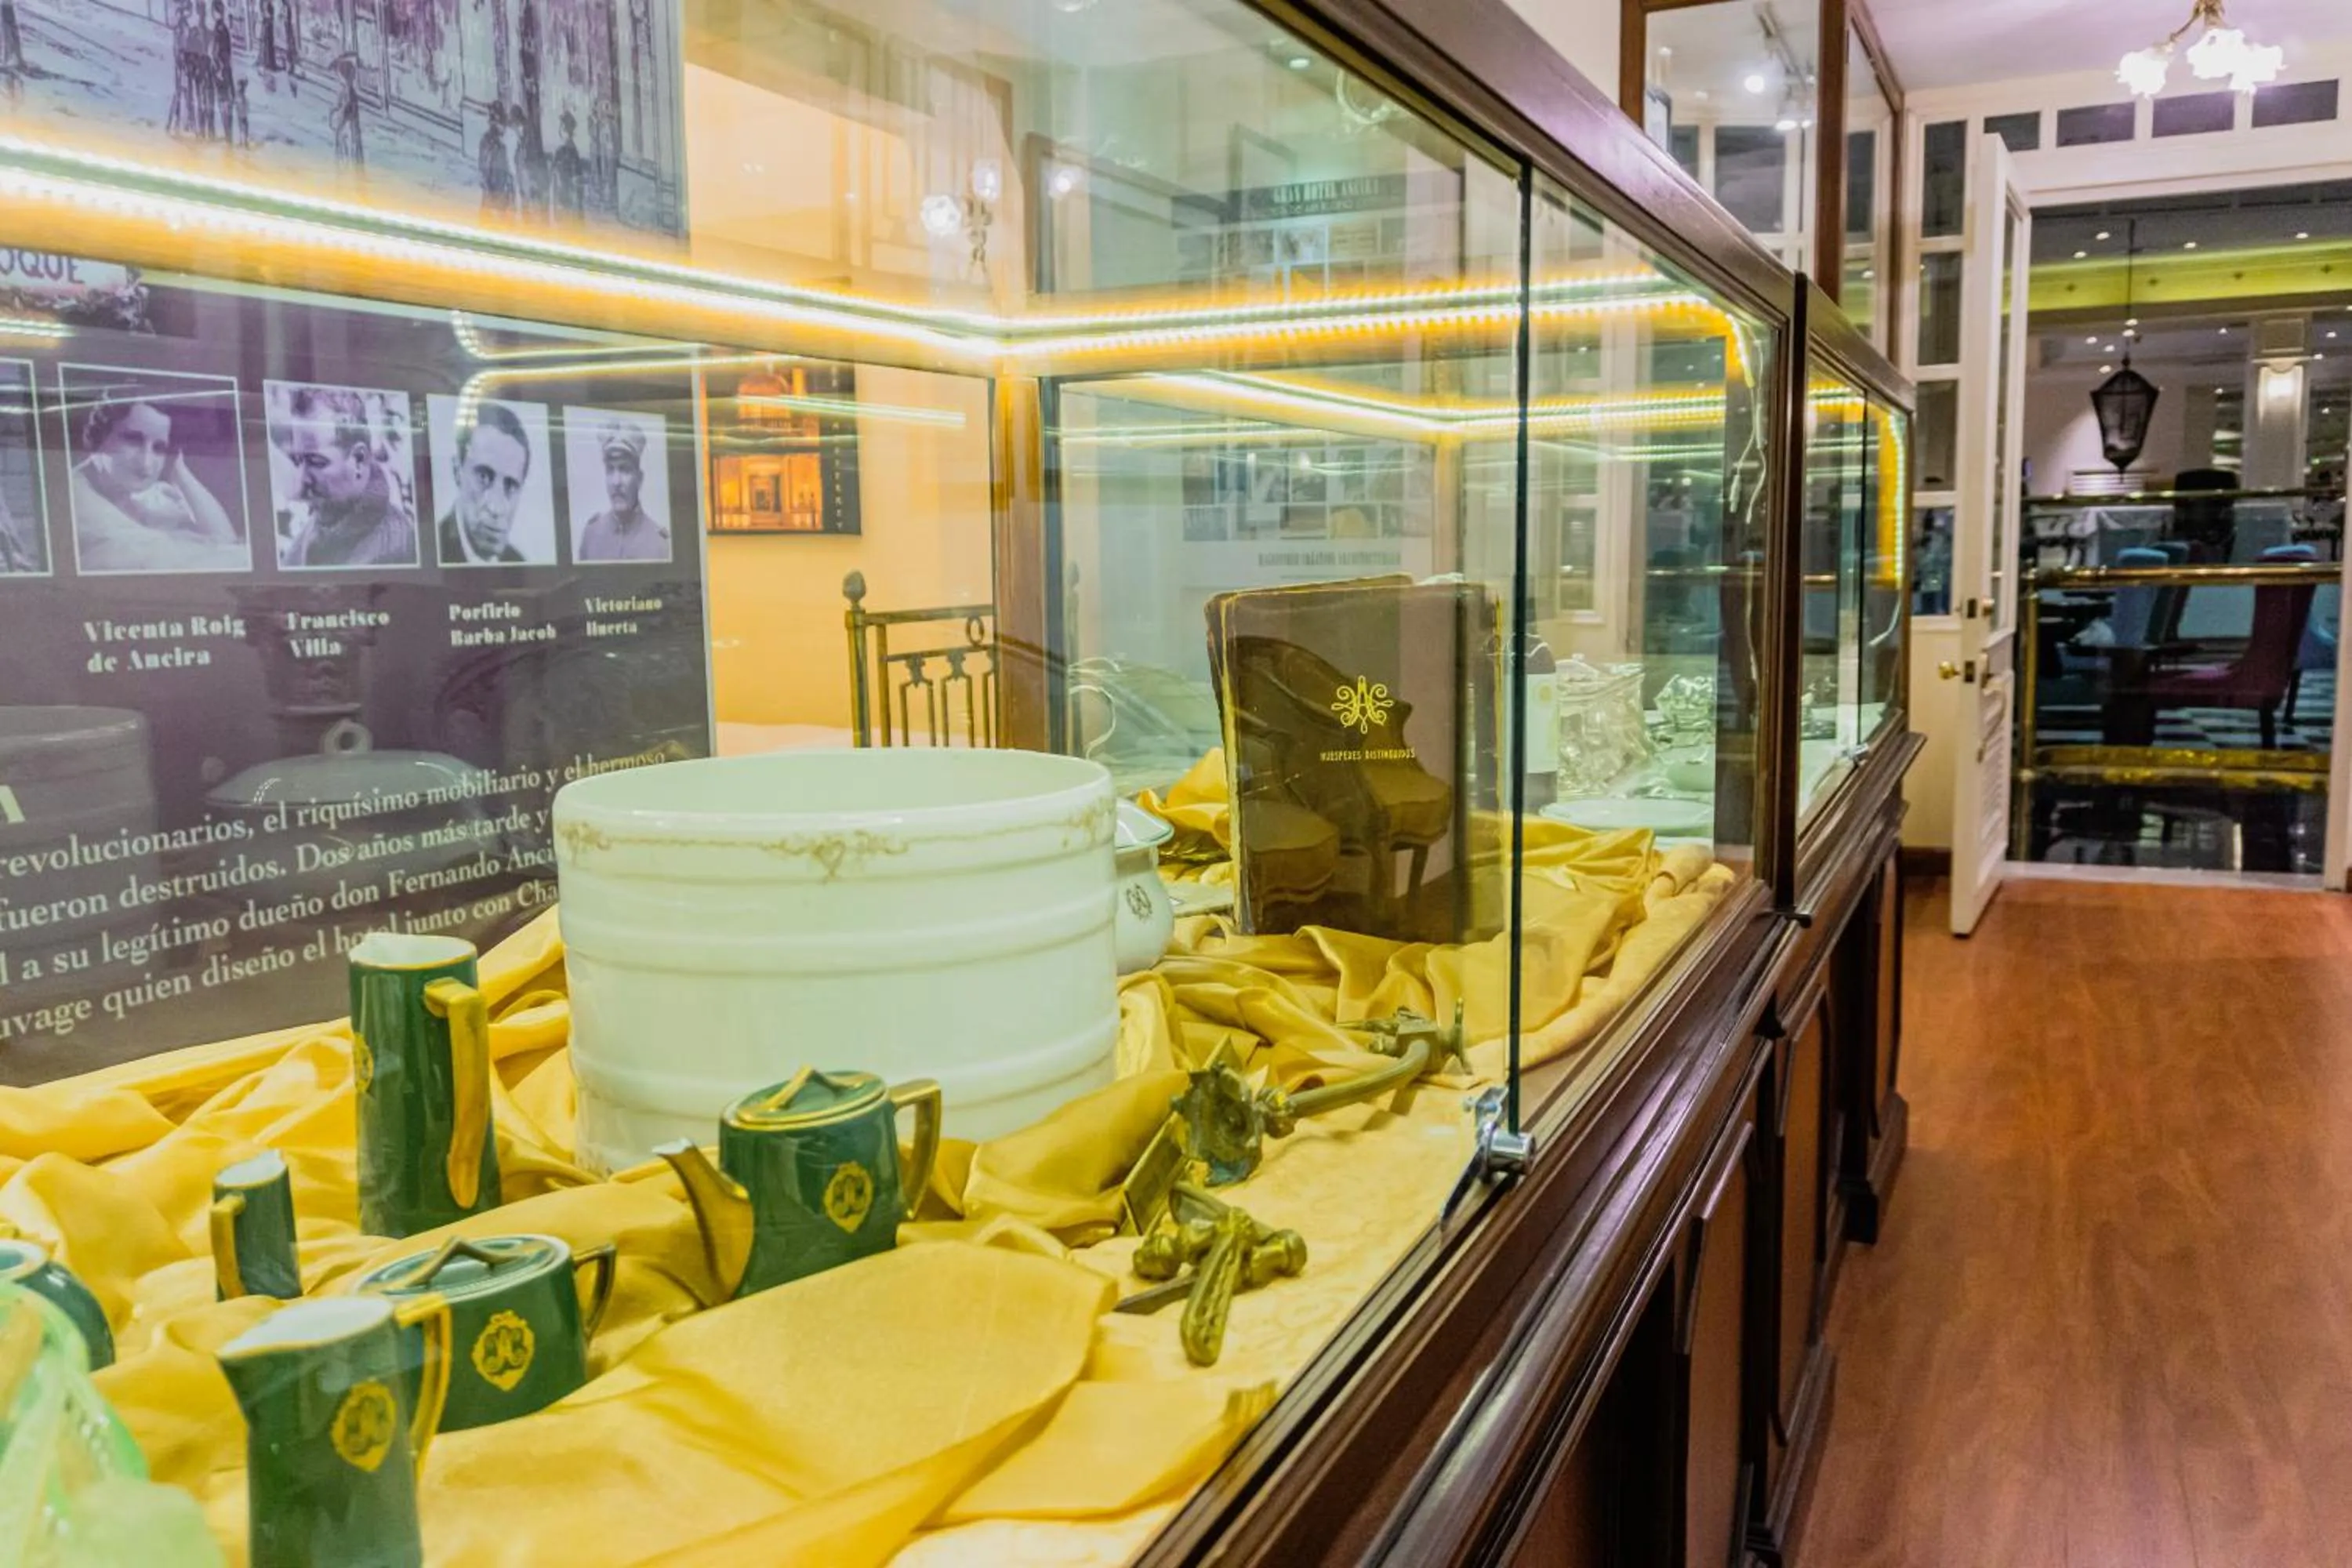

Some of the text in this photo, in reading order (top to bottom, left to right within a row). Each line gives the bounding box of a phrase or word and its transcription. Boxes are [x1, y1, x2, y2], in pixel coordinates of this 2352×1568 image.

[448, 601, 521, 621] Porfirio
[584, 596, 662, 614] Victoriano
[83, 615, 247, 642] Vicenta Roig
[287, 608, 391, 630] Francisco
[586, 620, 638, 637] Huerta
[451, 624, 557, 646] Barba Jacob
[87, 646, 212, 673] de Ancira
[289, 637, 343, 659] Villa
[263, 800, 288, 833] el
[296, 787, 419, 829] riquísimo
[426, 764, 540, 805] mobiliario
[545, 769, 559, 792] y
[564, 753, 582, 781] el
[119, 854, 287, 909] destruidos.
[296, 843, 350, 873] Dos
[358, 833, 414, 861] años
[421, 819, 467, 848] más
[473, 804, 531, 837] tarde
[535, 810, 549, 833] y
[22, 959, 42, 980] a
[53, 947, 89, 974] su
[101, 916, 230, 966] legítimo
[238, 894, 324, 931] dueño
[331, 879, 379, 910] don
[388, 851, 499, 898] Fernando
[102, 972, 192, 1022] quien
[202, 945, 296, 987] diseño
[303, 929, 327, 962] el
[405, 907, 466, 935] junto
[473, 895, 510, 919] con
